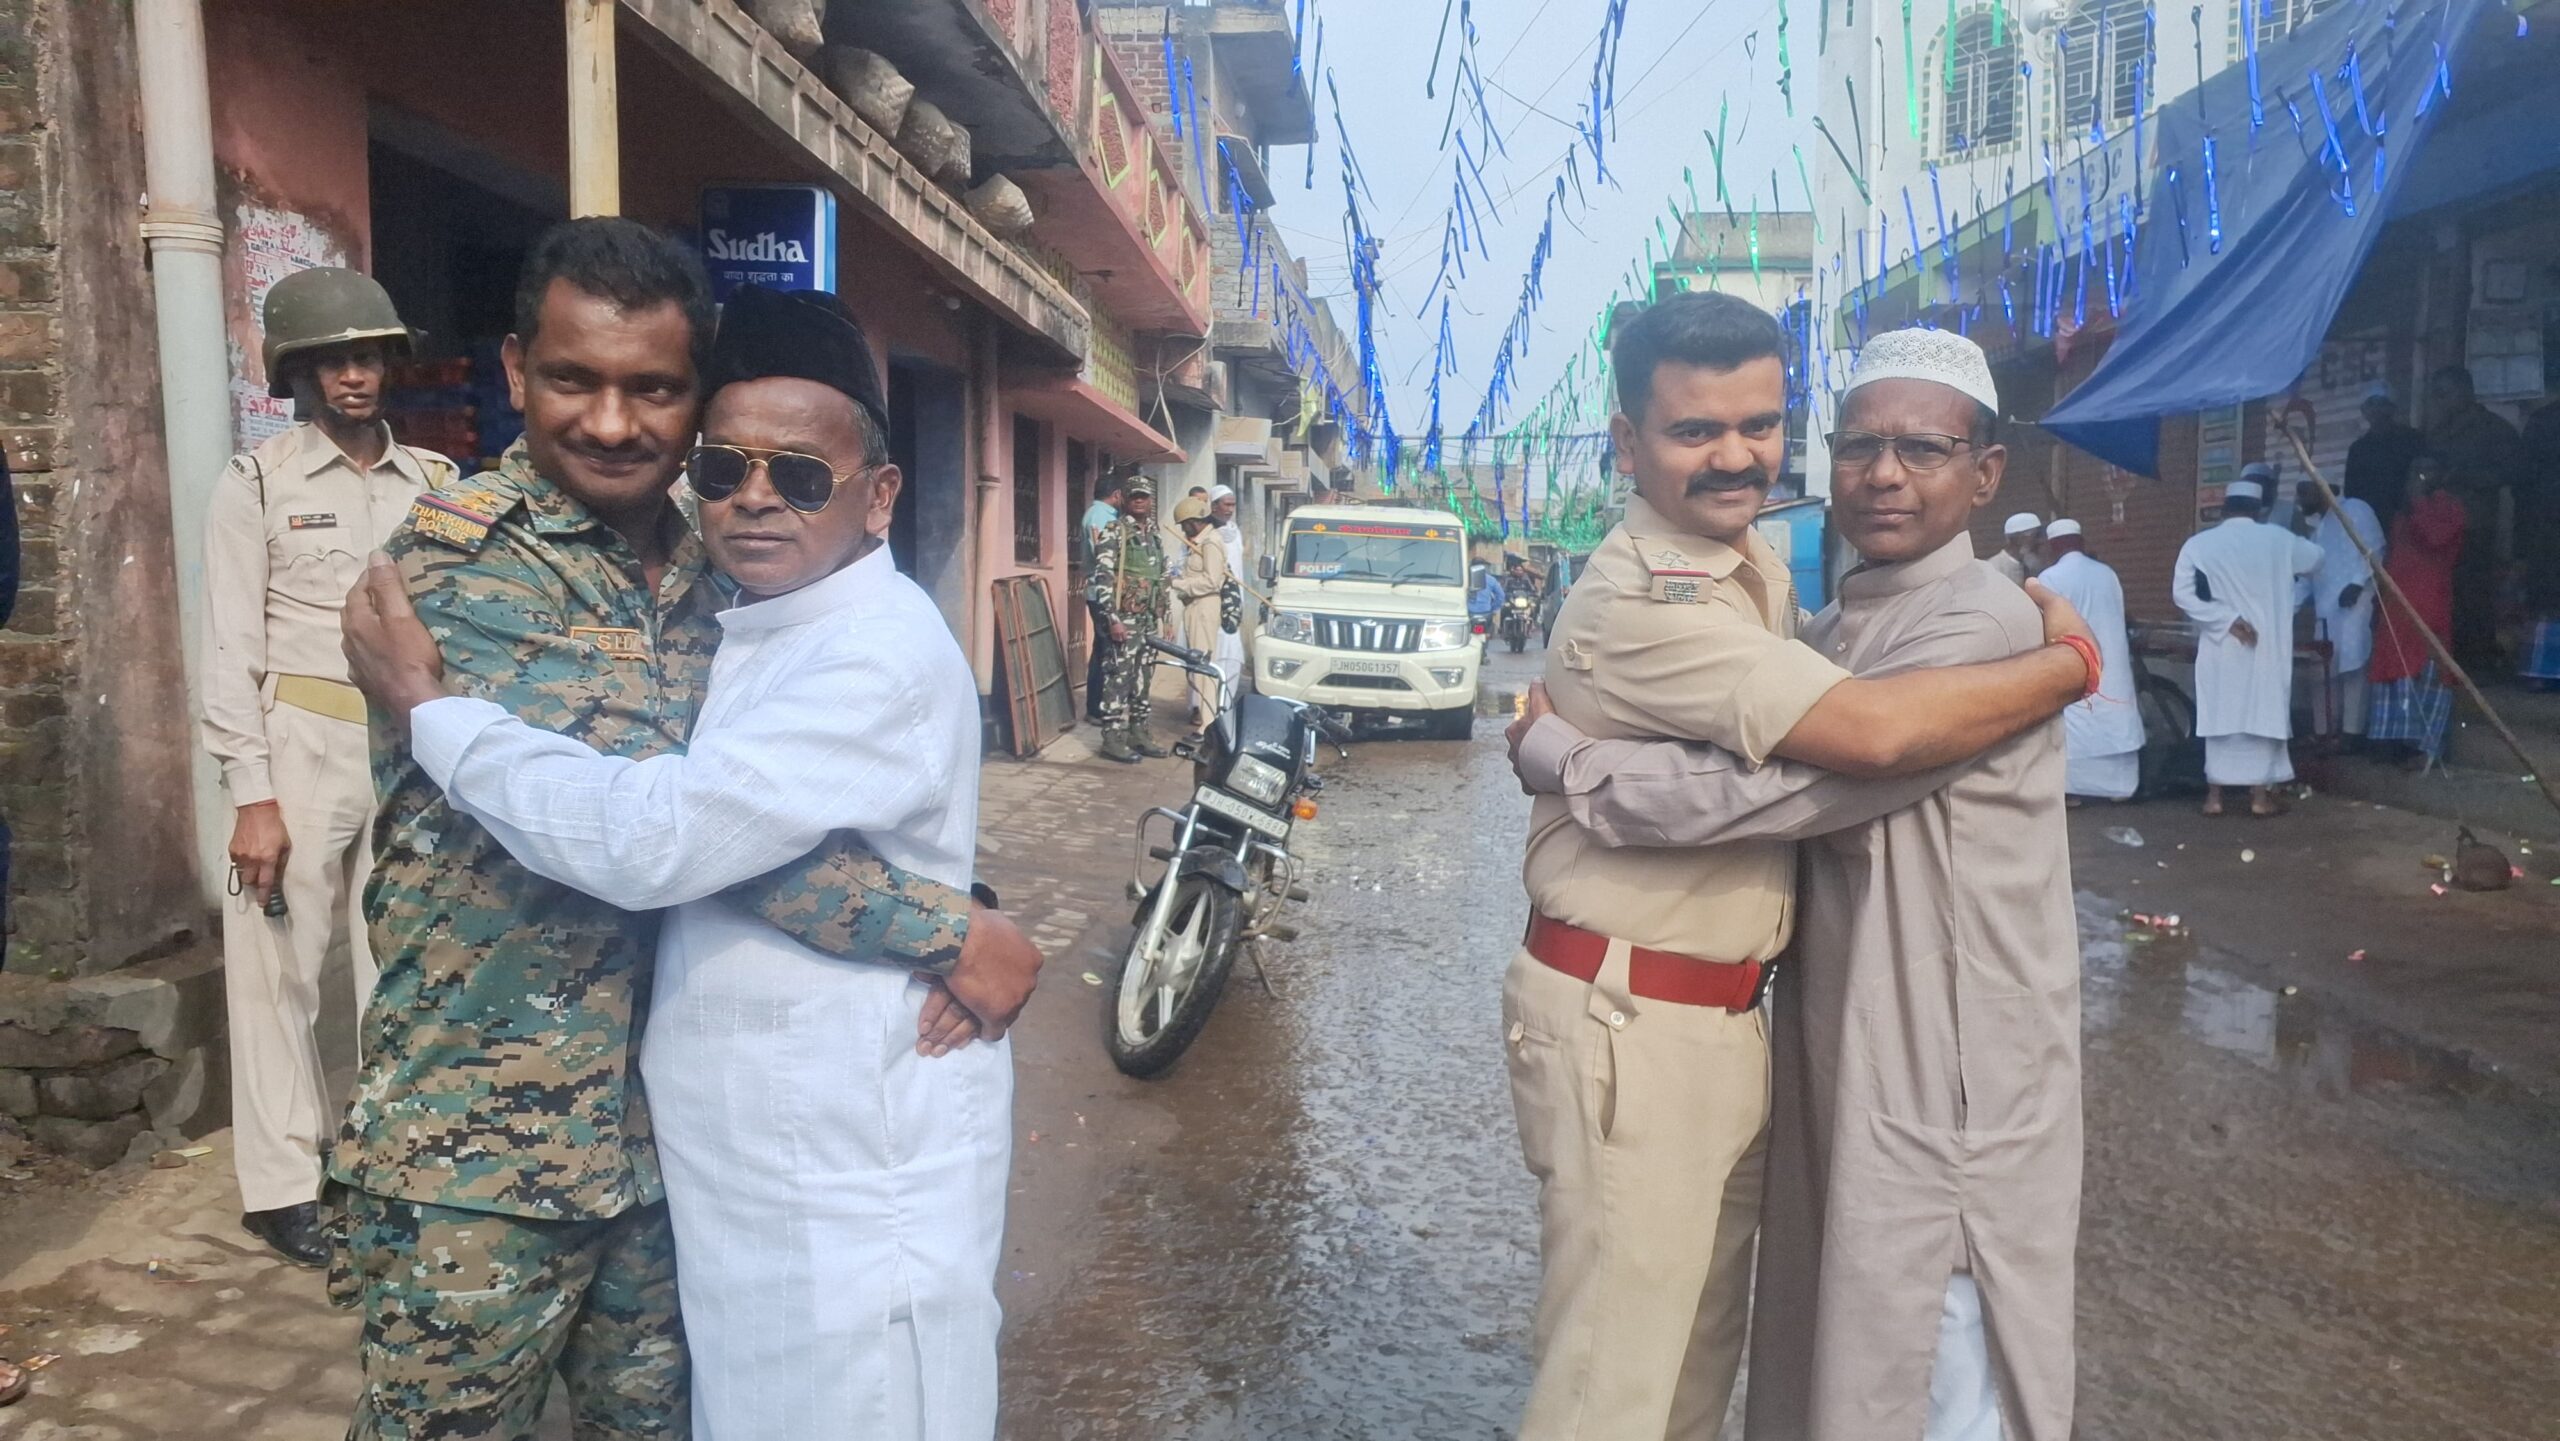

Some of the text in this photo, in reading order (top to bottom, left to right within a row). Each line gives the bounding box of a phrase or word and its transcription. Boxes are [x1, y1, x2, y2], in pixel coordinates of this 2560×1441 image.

[708, 228, 809, 263] Sudha
[779, 272, 794, 282] का
[411, 502, 488, 539] JHARKHAND
[414, 517, 469, 544] POLICE
